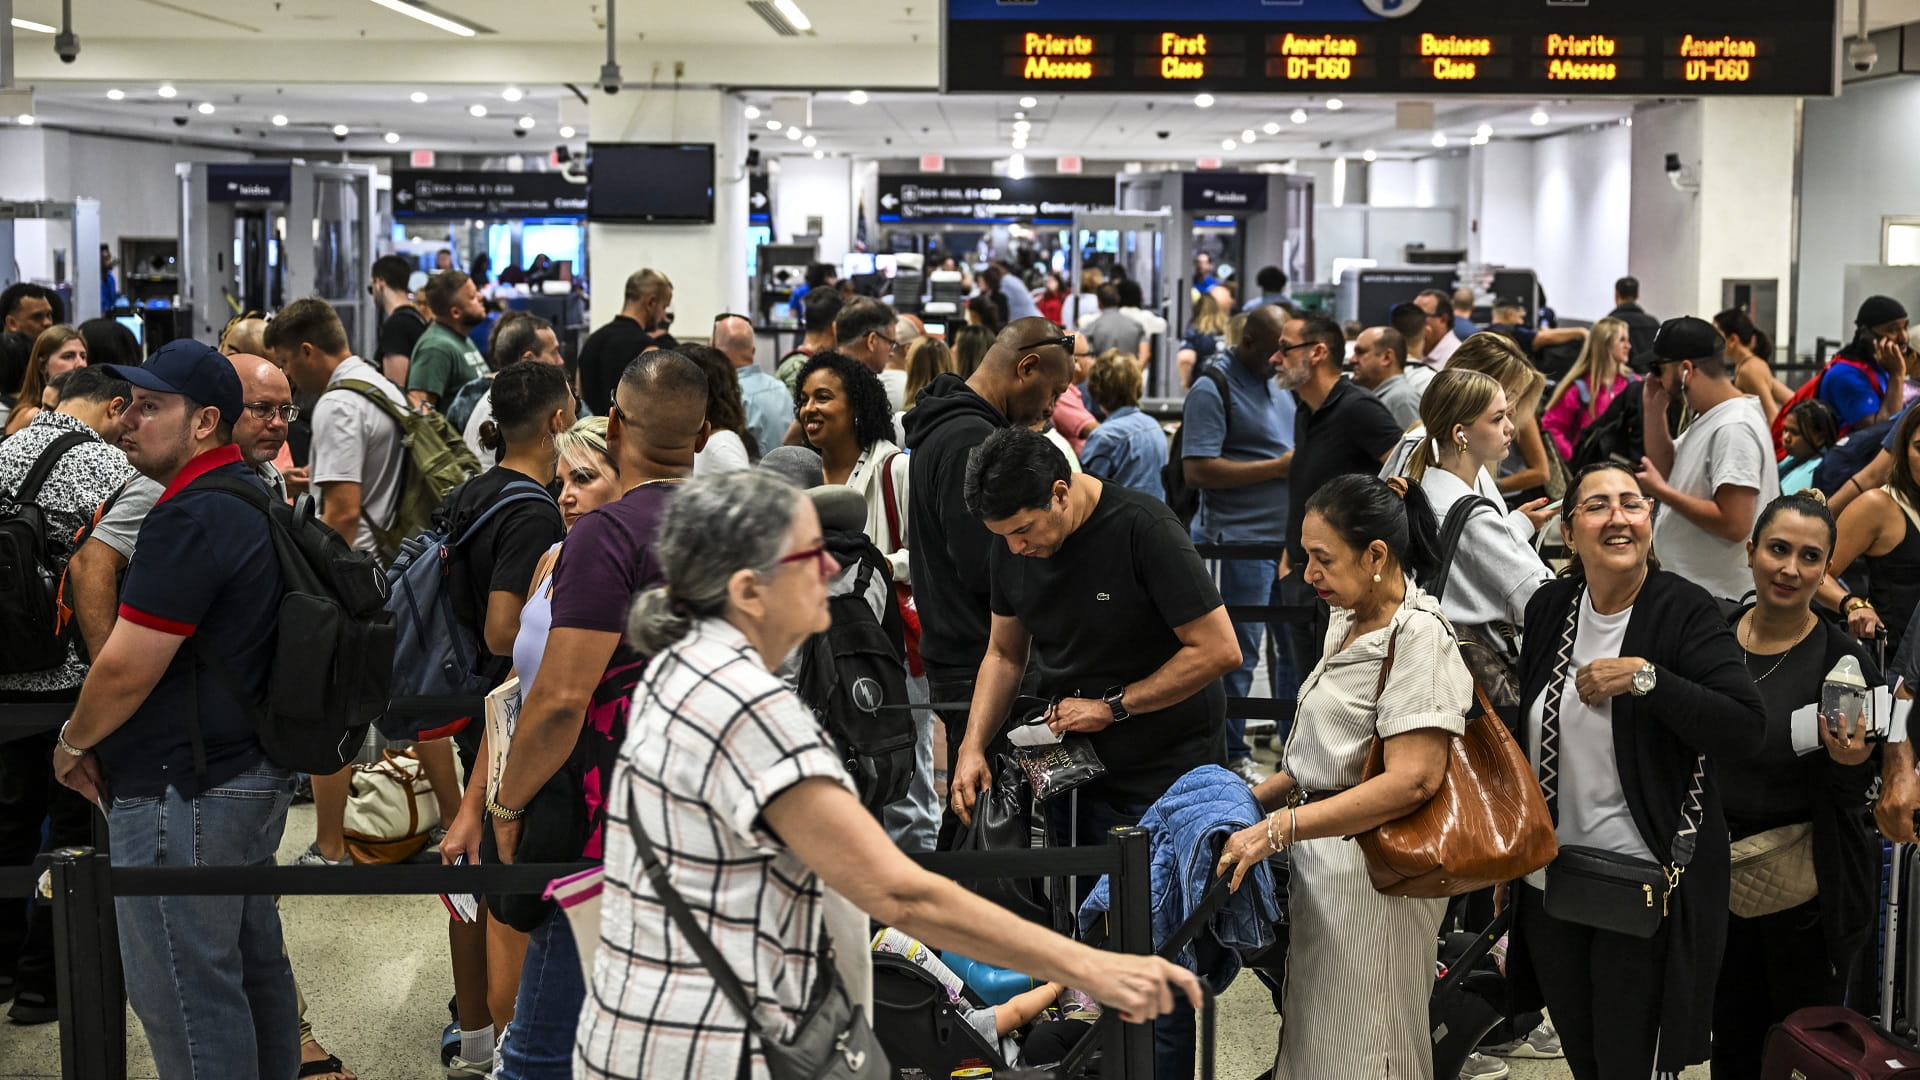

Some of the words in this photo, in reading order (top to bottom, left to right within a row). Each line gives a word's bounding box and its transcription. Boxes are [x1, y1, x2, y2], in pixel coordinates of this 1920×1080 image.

[1024, 32, 1093, 56] Priority
[1161, 32, 1207, 56] First
[1281, 32, 1358, 56] American
[1420, 33, 1491, 56] Business
[1547, 33, 1615, 57] Priority
[1680, 34, 1756, 58] American
[1023, 56, 1093, 79] AAccess
[1160, 56, 1204, 79] Class
[1286, 57, 1351, 80] D1-D60
[1433, 57, 1476, 80] Class
